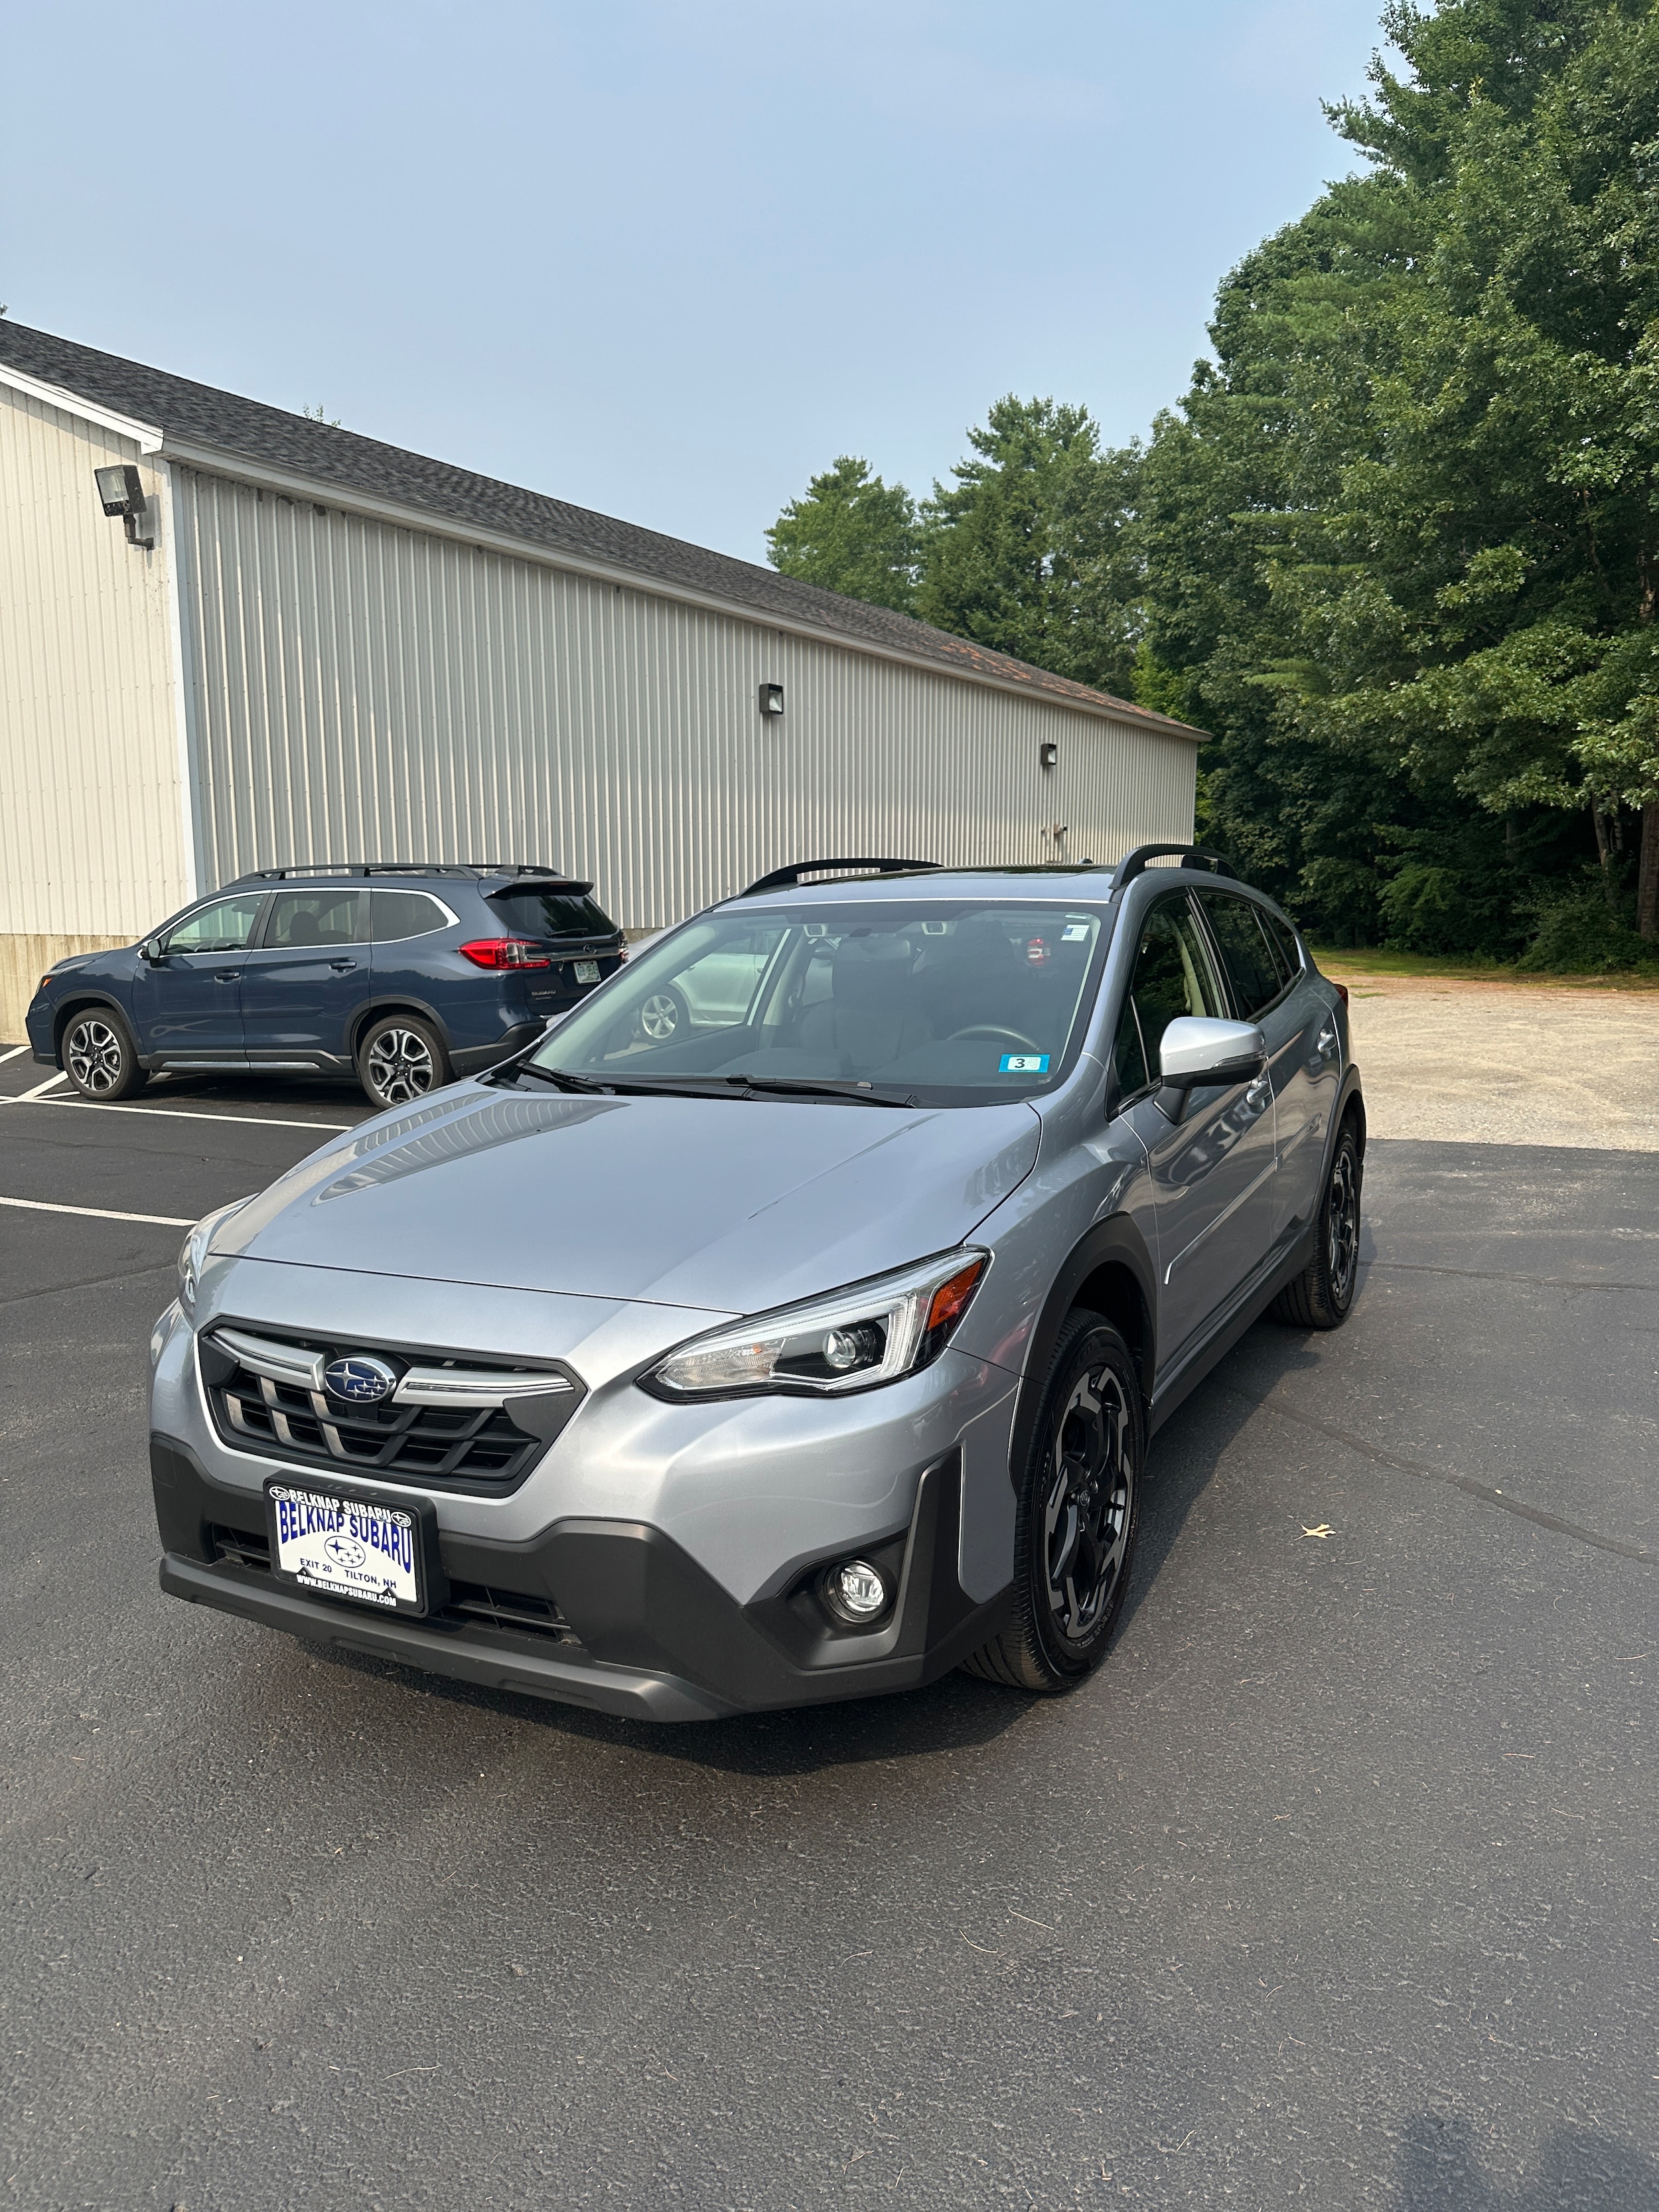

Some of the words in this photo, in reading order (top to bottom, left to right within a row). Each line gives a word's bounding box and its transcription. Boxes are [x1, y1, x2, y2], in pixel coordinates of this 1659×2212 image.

[1015, 1059, 1025, 1069] 3
[289, 1489, 340, 1511] BELKNAP
[342, 1501, 392, 1523] SUBARU
[279, 1501, 344, 1544] BELKNAP
[350, 1514, 411, 1574] SUBARU
[300, 1558, 319, 1569] EXIT
[296, 1574, 397, 1607] WWW.BELKNAPSUBARU.COM
[344, 1570, 380, 1586] TILTON,
[383, 1578, 397, 1588] NH
